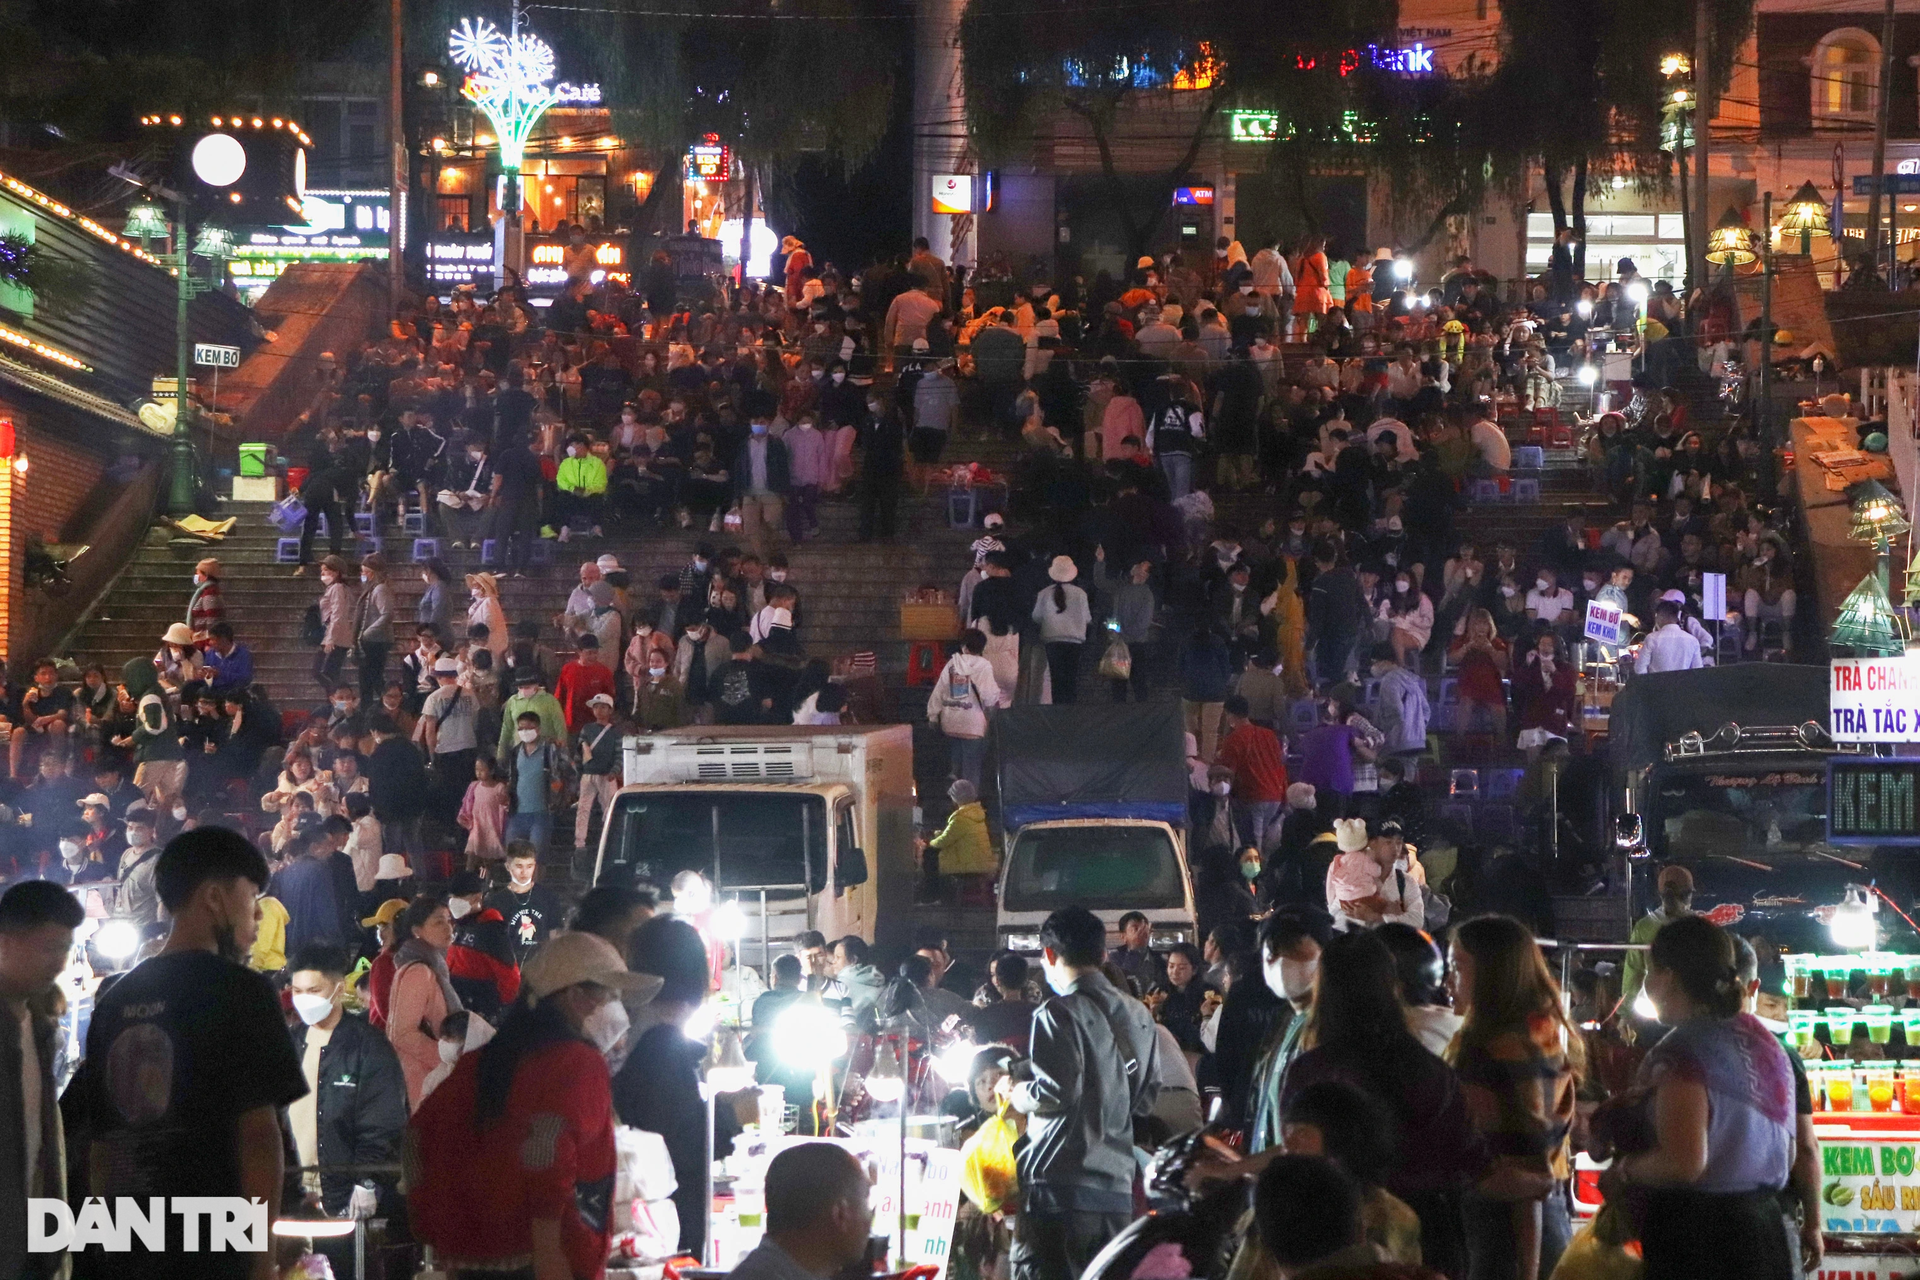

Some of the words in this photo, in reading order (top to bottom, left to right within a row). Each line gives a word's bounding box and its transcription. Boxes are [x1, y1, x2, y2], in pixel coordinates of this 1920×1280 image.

[1426, 28, 1451, 37] NAM
[197, 349, 220, 363] KEM
[1590, 605, 1607, 621] KEM
[1587, 621, 1602, 635] KEM
[1834, 660, 1862, 691] TRÀ
[1833, 703, 1867, 733] TRÀ
[1873, 699, 1907, 733] TẮC
[1835, 773, 1913, 829] KEM
[1823, 1146, 1875, 1175] KEM
[1881, 1146, 1915, 1176] BƠ
[1901, 1186, 1920, 1210] RI
